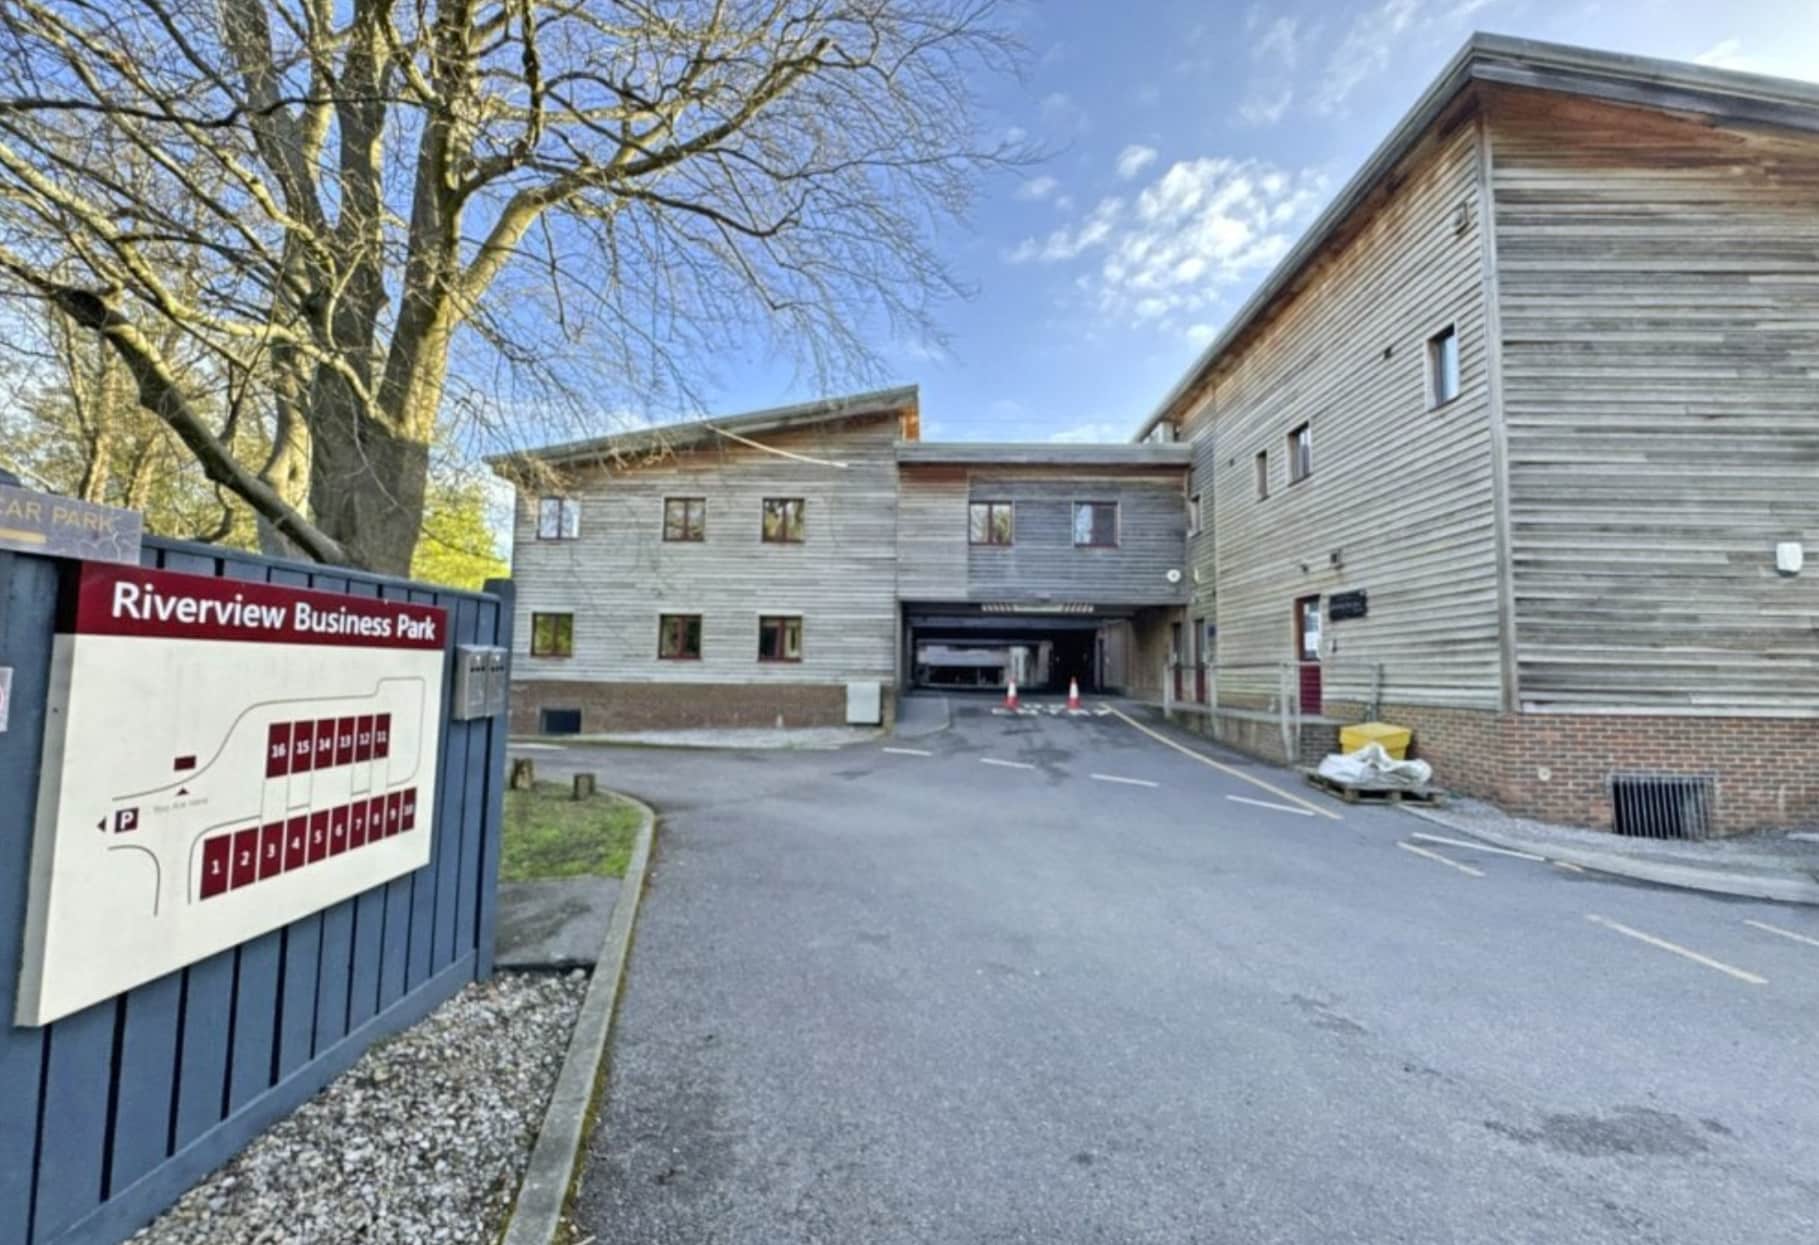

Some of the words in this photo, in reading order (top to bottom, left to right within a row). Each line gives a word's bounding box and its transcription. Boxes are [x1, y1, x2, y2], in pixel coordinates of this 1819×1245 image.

[52, 506, 119, 535] PARK
[111, 582, 285, 630] Riverview
[293, 602, 391, 638] Business
[397, 613, 436, 640] Park
[319, 737, 332, 752] 14
[339, 734, 352, 748] 13
[359, 732, 370, 746] 12
[376, 730, 387, 744] 11
[271, 743, 287, 758] 16
[296, 739, 311, 754] 15
[119, 811, 134, 831] P
[372, 812, 381, 827] 8
[389, 807, 397, 821] 9
[334, 823, 344, 837] 6
[355, 818, 363, 831] 7
[291, 836, 301, 850] 4
[313, 829, 323, 845] 5
[239, 850, 250, 867] 2
[266, 843, 276, 859] 3
[210, 859, 221, 875] 1
